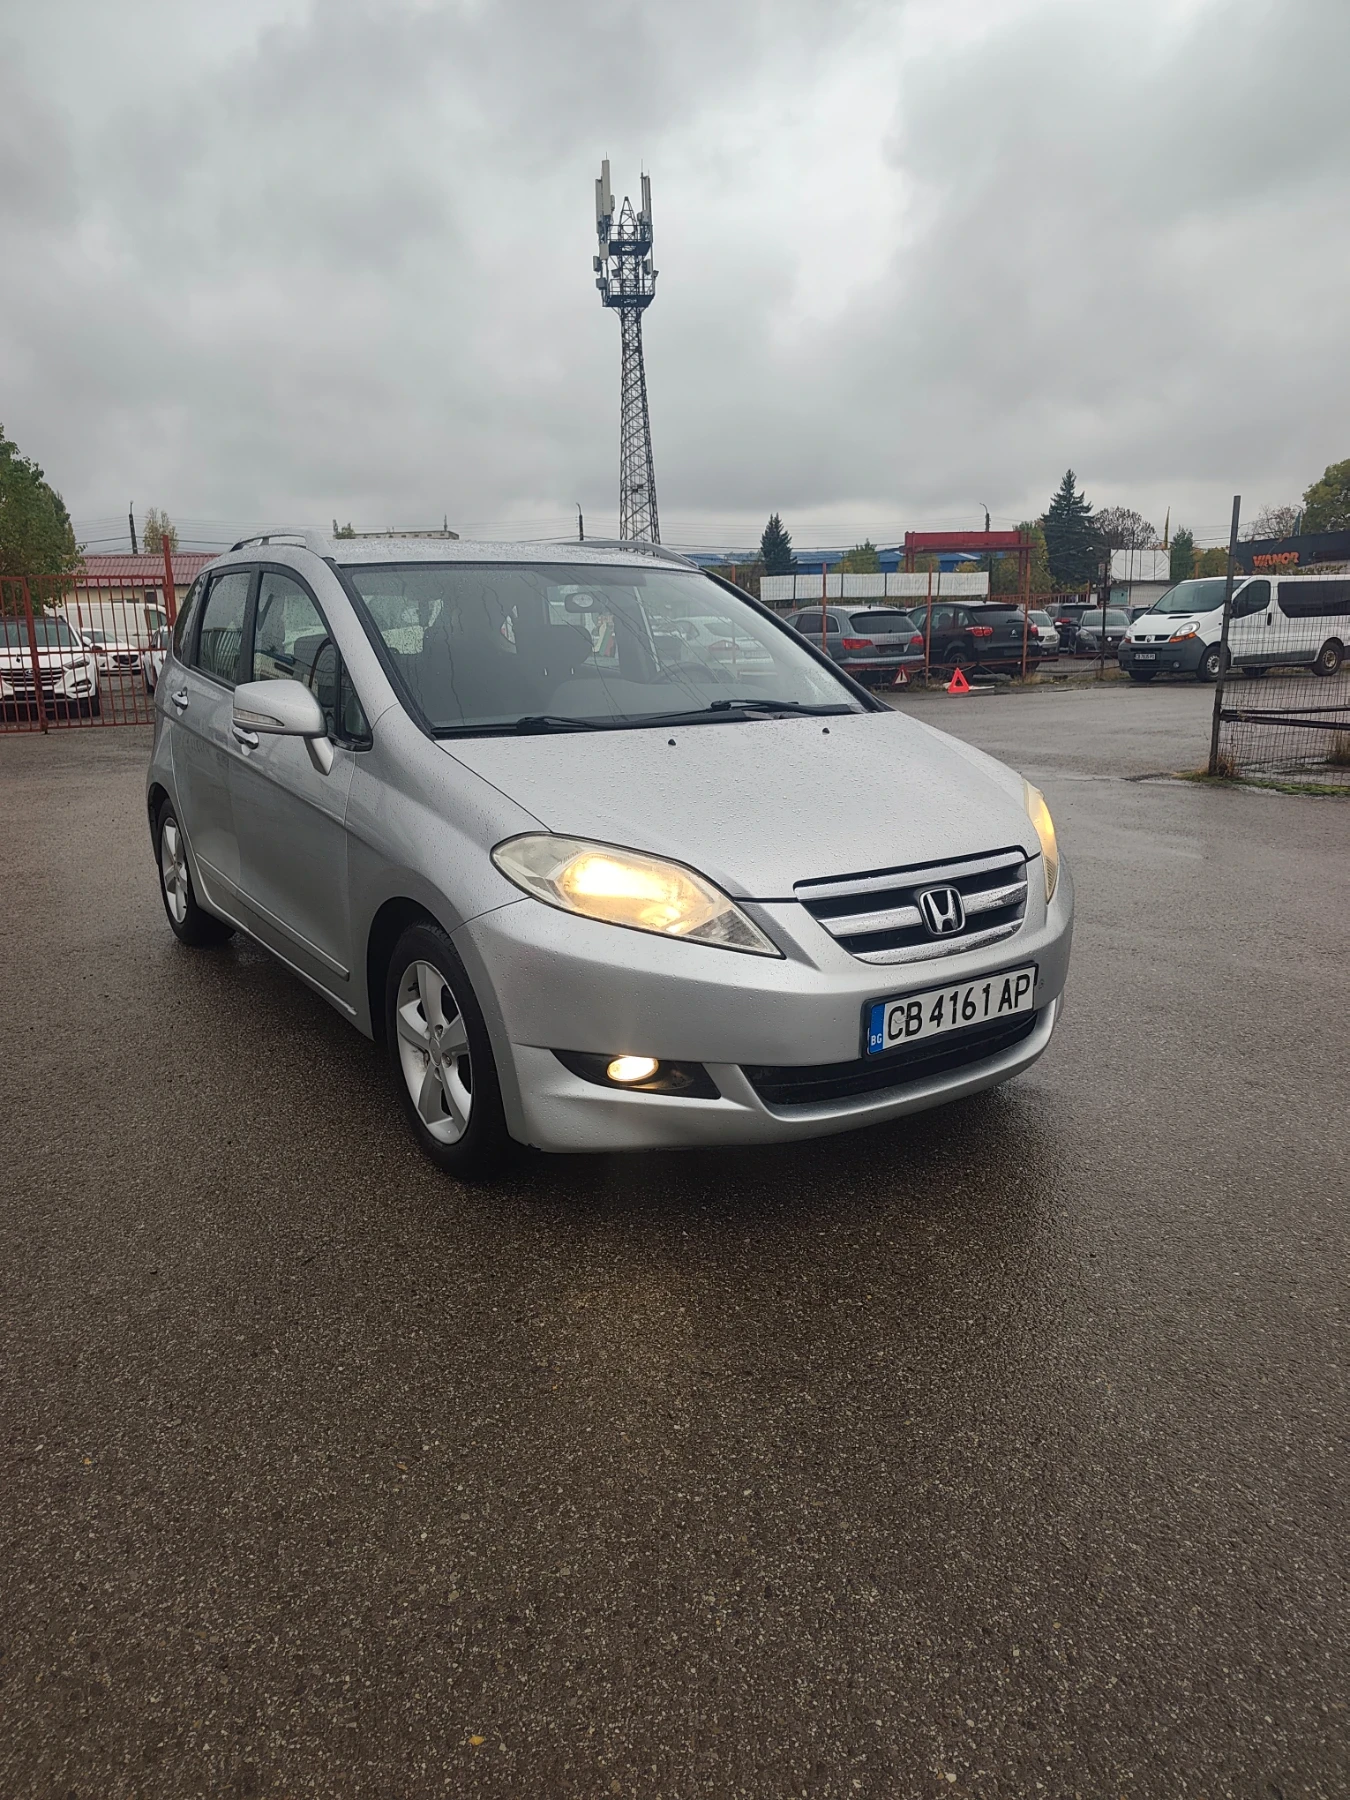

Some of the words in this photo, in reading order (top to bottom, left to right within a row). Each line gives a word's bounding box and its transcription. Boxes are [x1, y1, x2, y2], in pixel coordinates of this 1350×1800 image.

[887, 1000, 923, 1041] CB
[929, 983, 992, 1028] 4161
[997, 973, 1031, 1013] AP
[870, 1034, 883, 1047] BG
